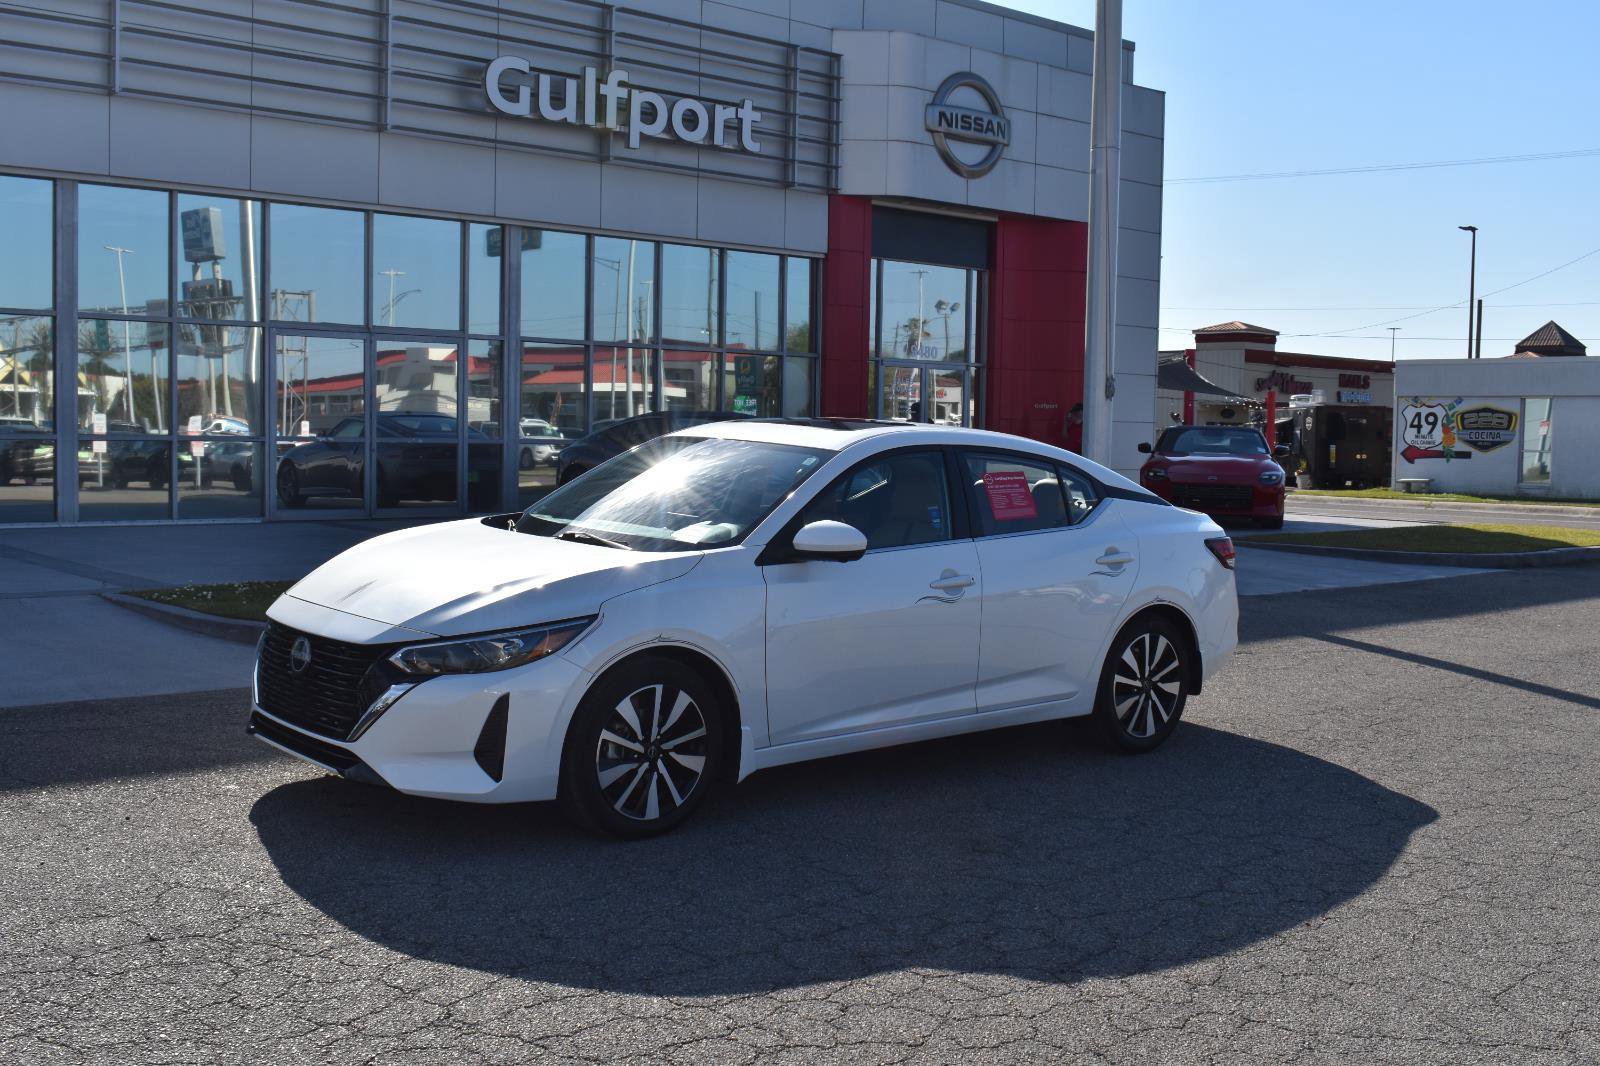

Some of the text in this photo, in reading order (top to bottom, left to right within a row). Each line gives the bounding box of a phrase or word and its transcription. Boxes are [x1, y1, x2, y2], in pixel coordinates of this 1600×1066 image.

[484, 55, 762, 154] Gulfport
[938, 111, 1006, 139] NISSAN
[1409, 411, 1438, 434] 49
[1463, 412, 1509, 429] 228
[1468, 431, 1502, 440] COCINA
